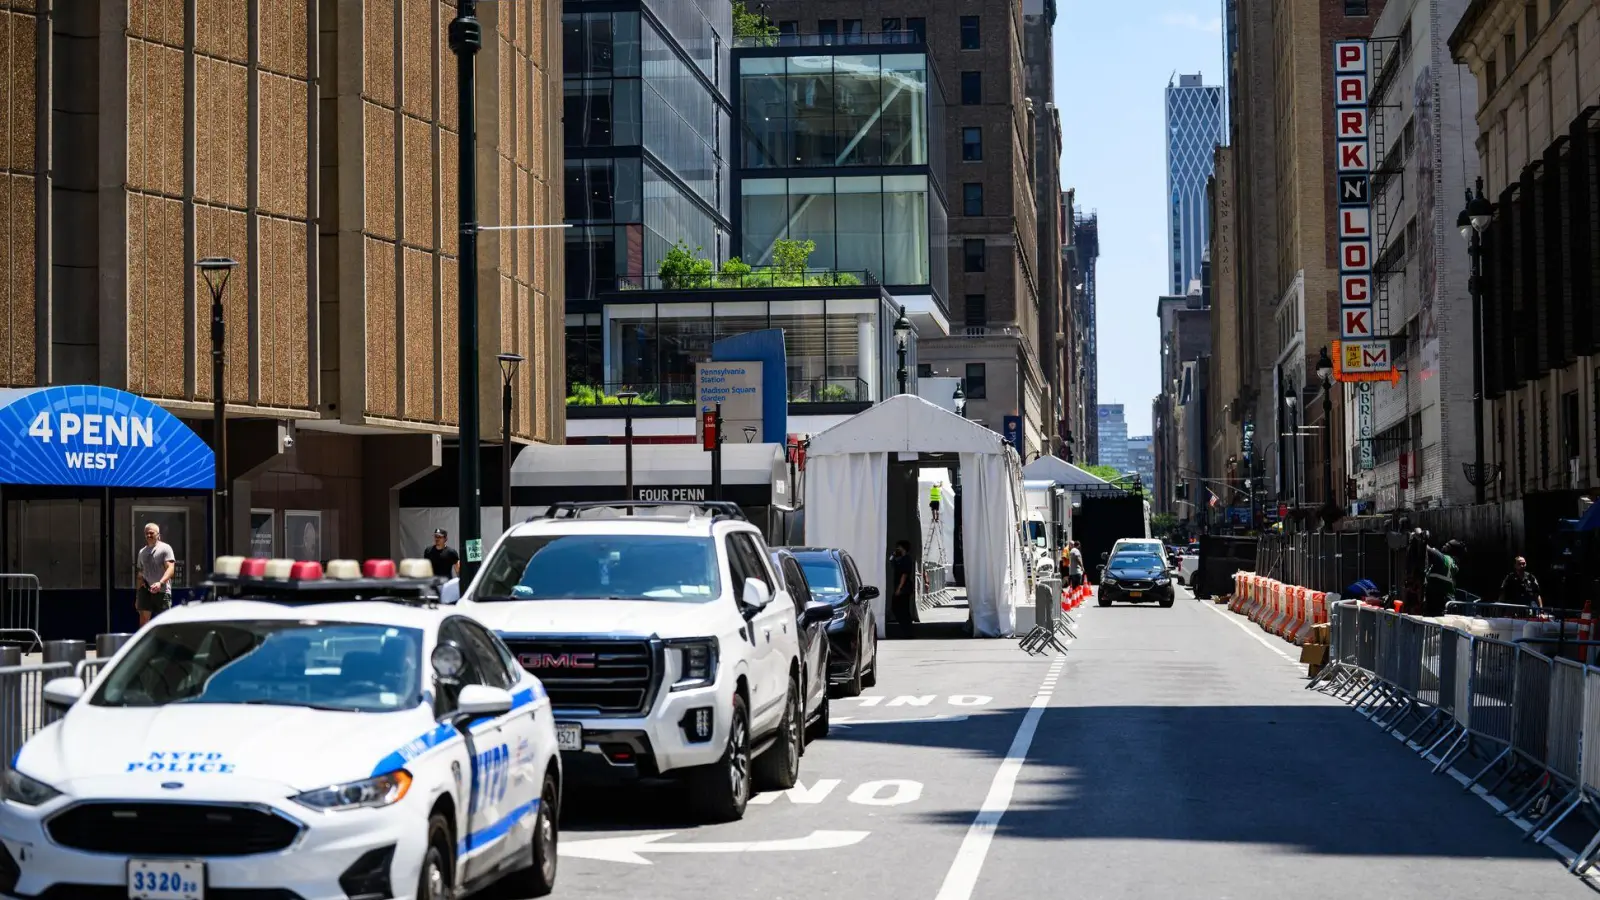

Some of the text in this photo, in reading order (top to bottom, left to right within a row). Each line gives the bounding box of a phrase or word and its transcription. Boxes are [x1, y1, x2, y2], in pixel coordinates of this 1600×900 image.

[1339, 46, 1364, 167] PARK
[1220, 179, 1229, 217] PENN
[1222, 224, 1231, 275] PLAZA
[1344, 212, 1368, 334] LOCK
[700, 368, 746, 376] Pennsylvania
[701, 386, 756, 395] Madison Square
[28, 411, 153, 448] 4 PENN
[65, 451, 118, 470] WEST
[639, 488, 705, 501] FOUR PENN
[518, 653, 596, 668] GMC
[149, 751, 223, 761] NYPD
[126, 762, 236, 774] POLICE
[134, 871, 181, 892] 3320
